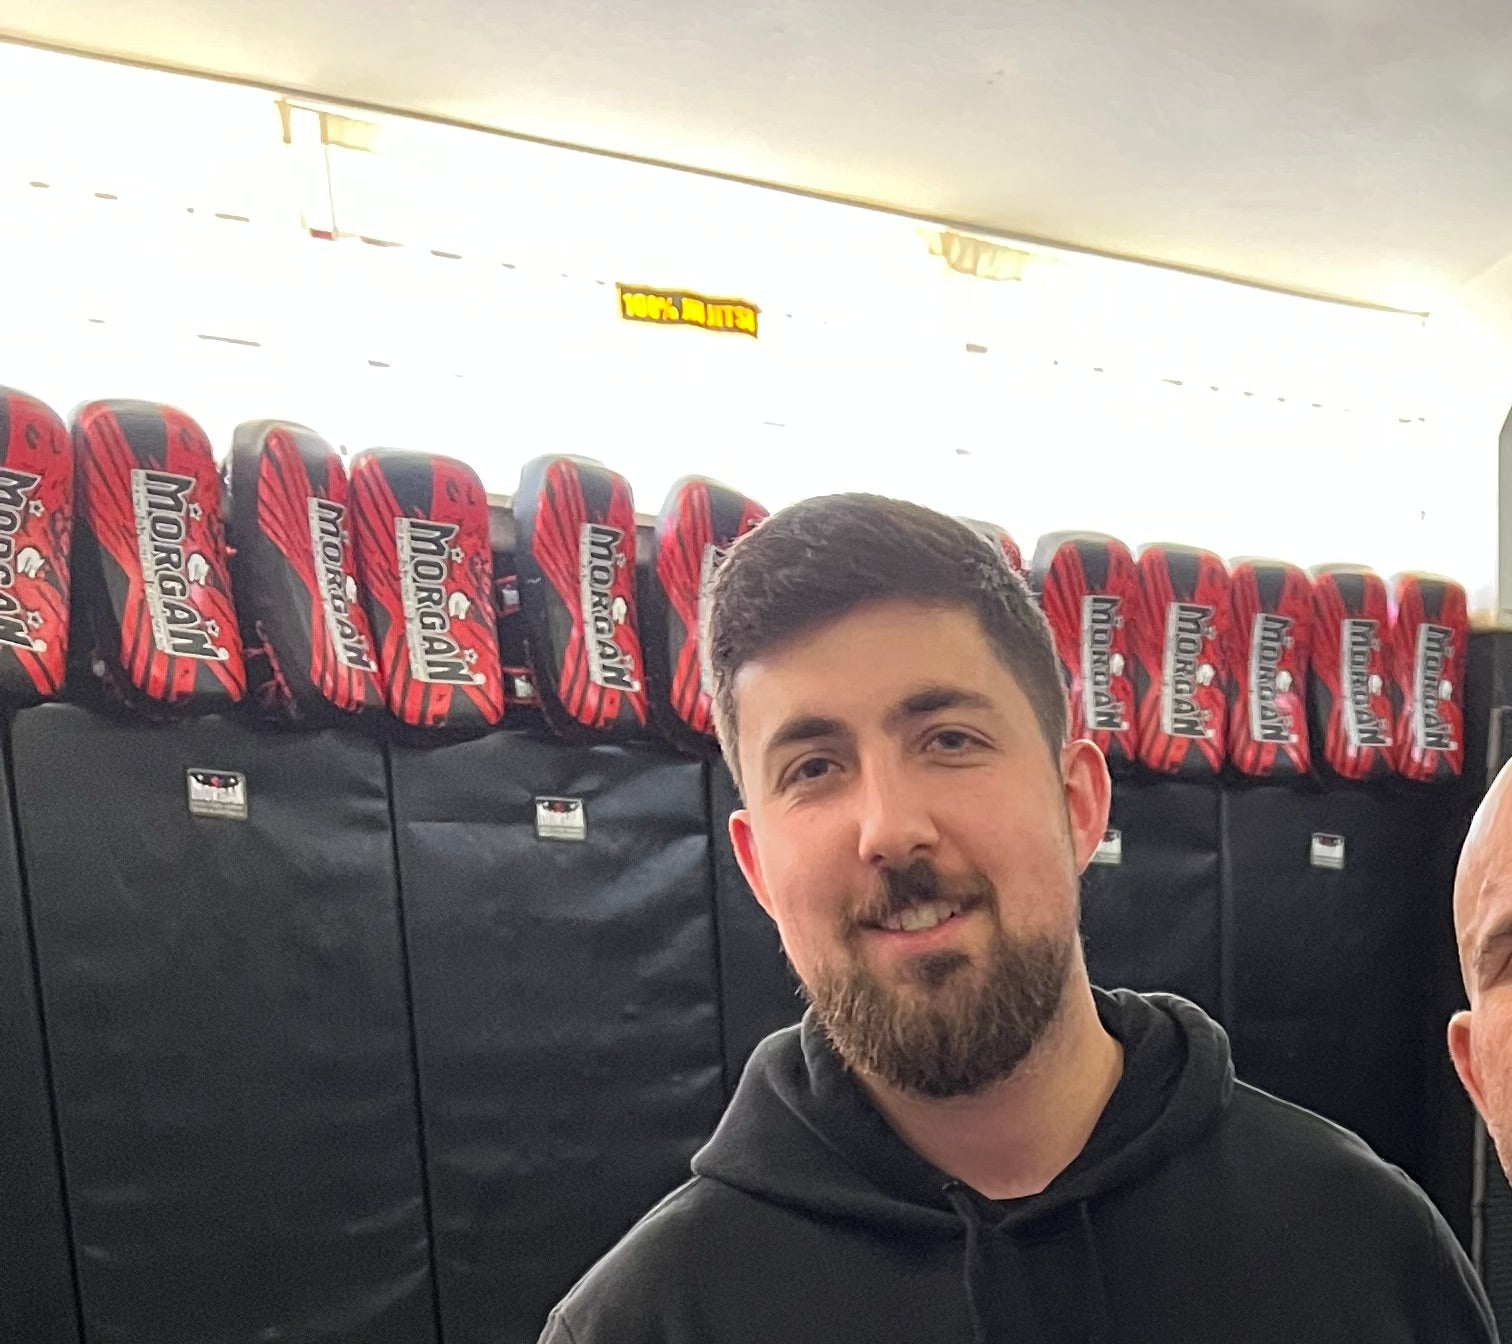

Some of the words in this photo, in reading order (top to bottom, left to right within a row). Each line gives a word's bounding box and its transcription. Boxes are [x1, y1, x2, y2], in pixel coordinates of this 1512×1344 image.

[147, 470, 229, 660] MORGAN
[317, 499, 378, 672] MORGAN
[409, 518, 487, 685] MORGAN
[589, 524, 641, 692] MORGAN
[1091, 596, 1130, 731] MORGAN
[1173, 603, 1217, 738] MORGAN
[1259, 614, 1299, 743] MORGAN
[1351, 619, 1393, 747] MORGAN
[1423, 625, 1458, 750] MORGAN
